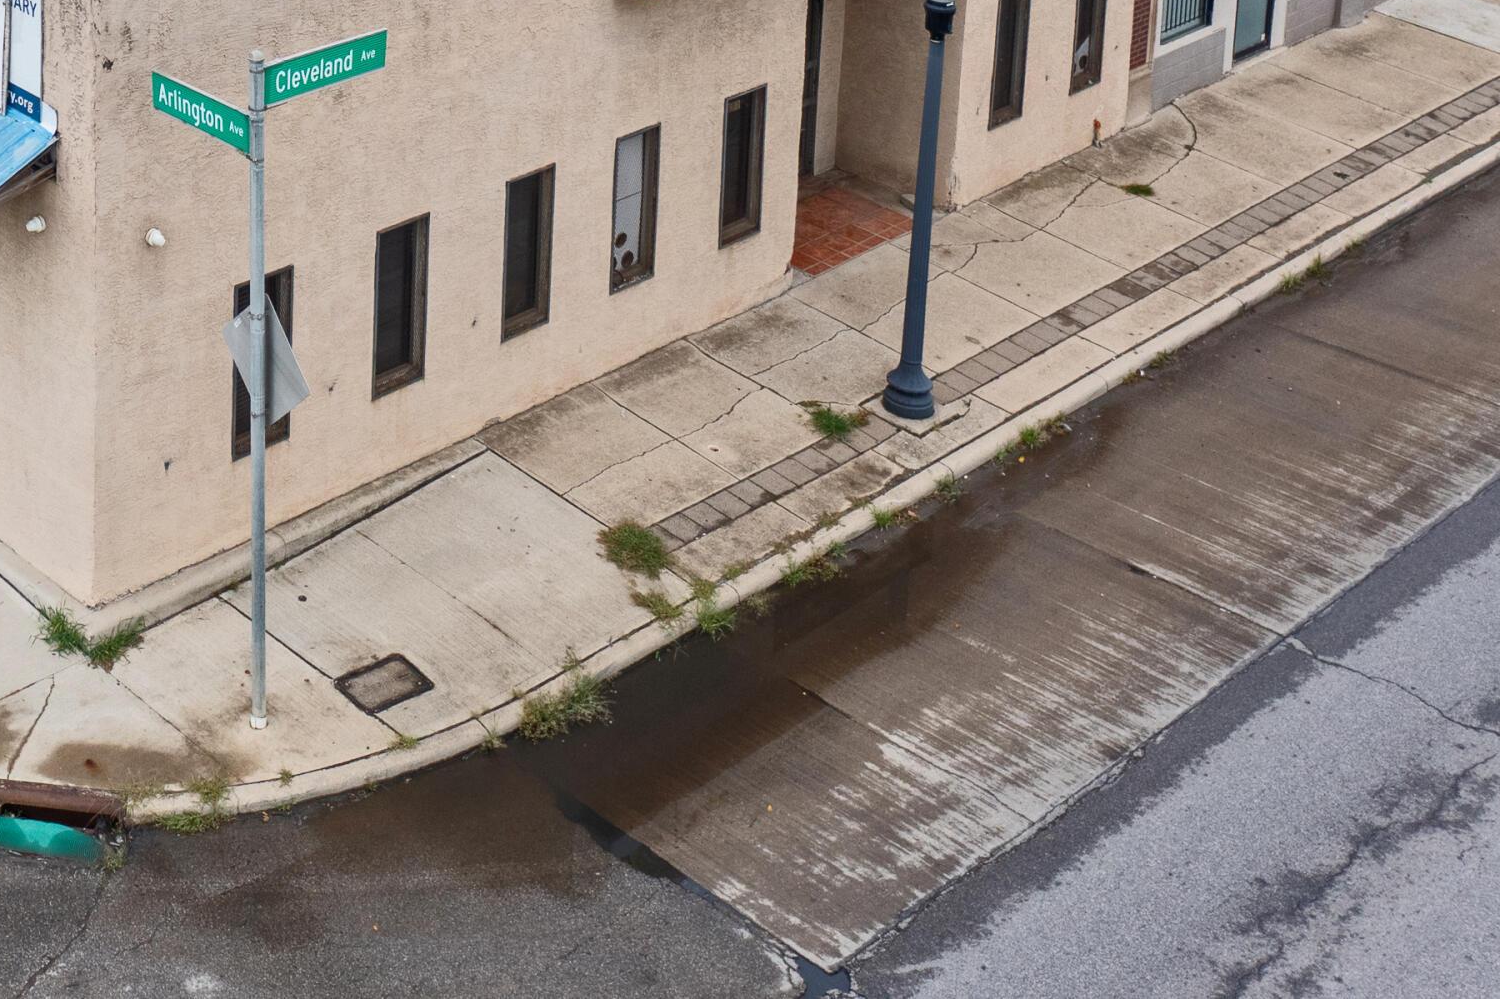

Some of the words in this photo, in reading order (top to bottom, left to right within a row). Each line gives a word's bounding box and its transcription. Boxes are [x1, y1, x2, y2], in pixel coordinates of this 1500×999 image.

[275, 49, 354, 94] Cleveland
[360, 49, 376, 62] Ave
[158, 83, 224, 133] Arlington
[229, 121, 244, 138] Ave
